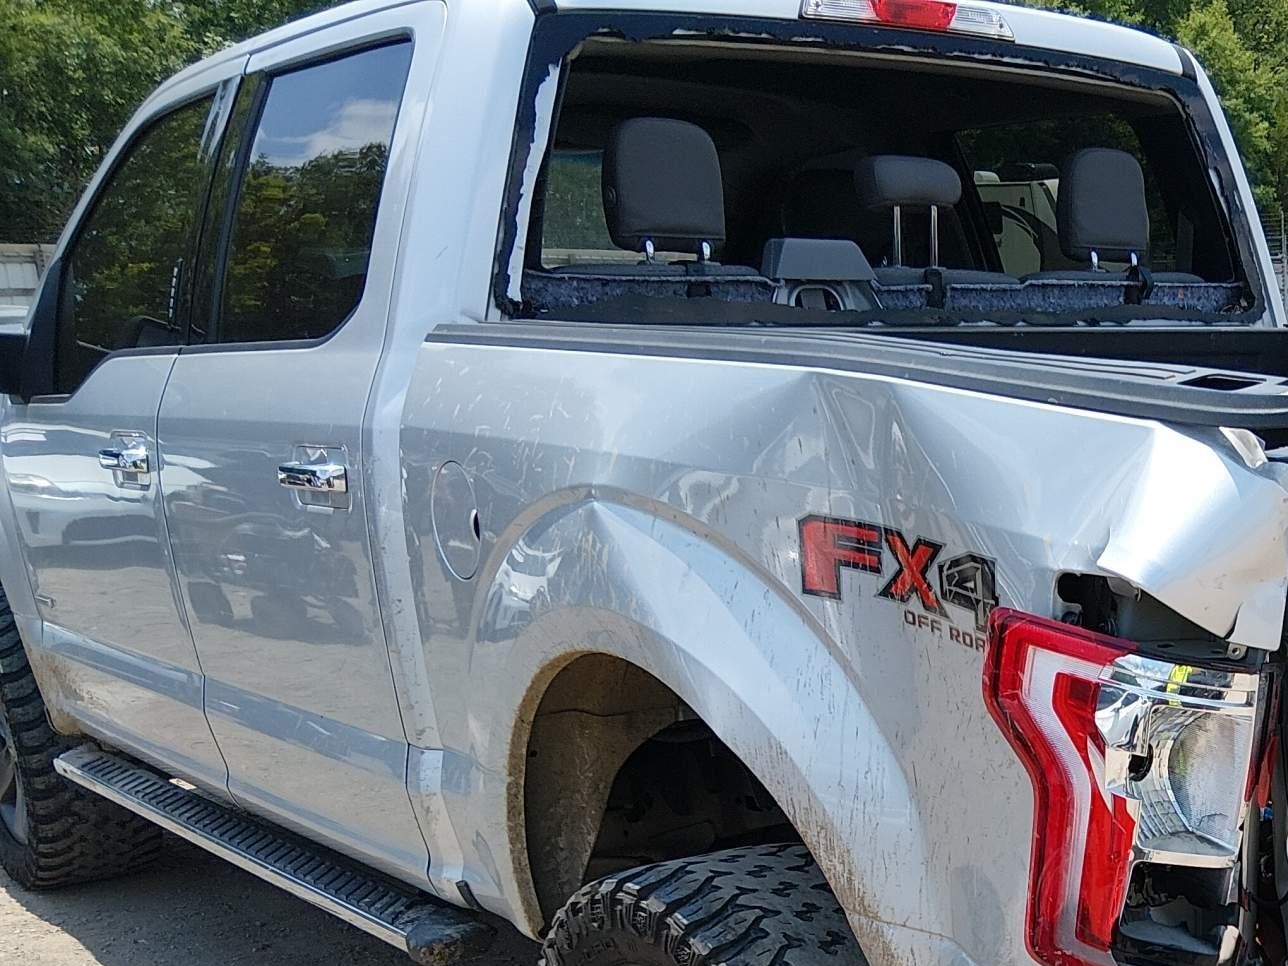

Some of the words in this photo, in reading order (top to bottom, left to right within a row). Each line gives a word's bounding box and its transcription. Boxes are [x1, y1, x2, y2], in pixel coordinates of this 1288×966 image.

[797, 514, 1000, 633] FX4
[903, 607, 943, 634] OFF
[948, 623, 987, 653] ROA
